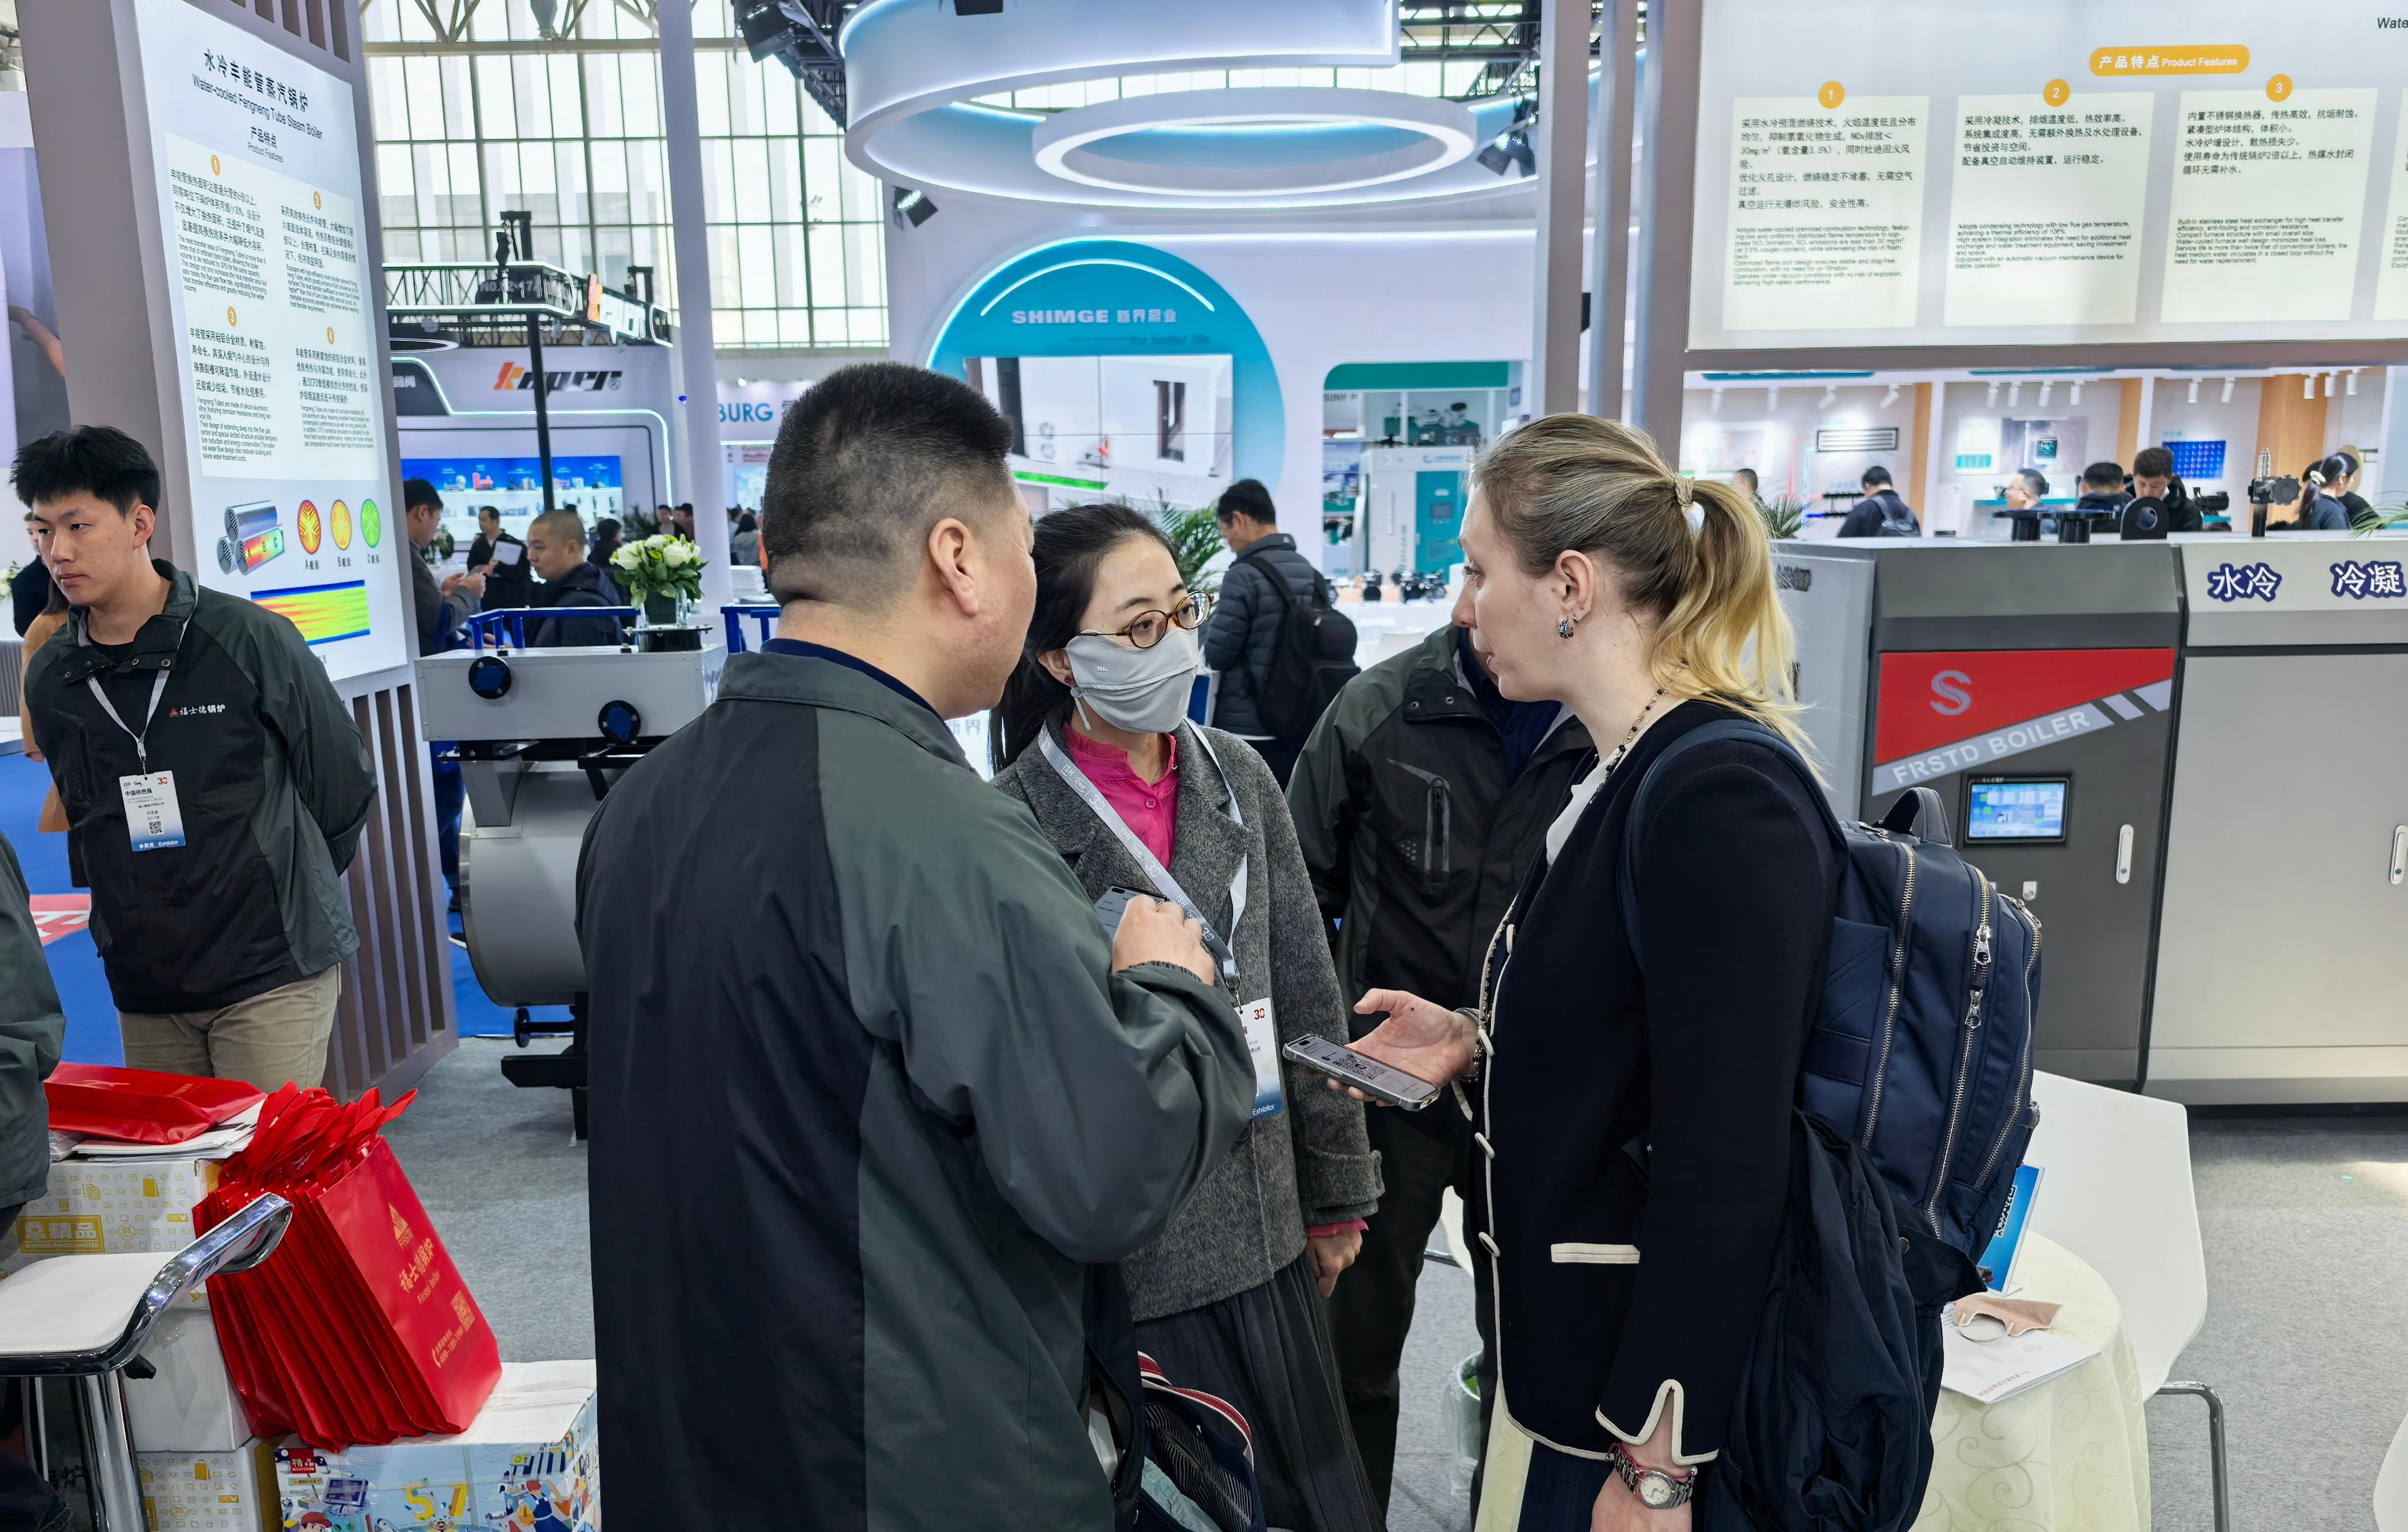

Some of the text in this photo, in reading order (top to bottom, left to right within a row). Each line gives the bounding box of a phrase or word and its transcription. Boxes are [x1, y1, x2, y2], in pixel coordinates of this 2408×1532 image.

[2099, 55, 2238, 69] 产品特点 Product Features
[203, 48, 309, 112] 水冷丰能管蒸汽锅炉
[2275, 82, 2282, 93] 3
[2052, 88, 2060, 98] 2
[192, 73, 237, 103] Water-cooled
[270, 107, 286, 124] Tube
[287, 115, 305, 132] Steam
[306, 122, 322, 139] Boiler
[250, 125, 277, 148] 产品特点
[1012, 309, 1176, 325] SHIMGE 新界泵业
[262, 541, 266, 552] B
[2212, 567, 2279, 598] 水冷
[2335, 563, 2404, 597] 冷凝
[1930, 670, 1971, 716] S
[179, 704, 225, 716] 福士德锅炉
[1987, 711, 2091, 755] BOILER
[1062, 764, 1075, 777] ISH
[1075, 779, 1086, 791] CIHE
[1121, 828, 1132, 841] ISH
[1175, 894, 1188, 908] ISH
[1252, 1104, 1275, 1116] Exhibitor
[399, 1237, 434, 1292] 福士德锅炉
